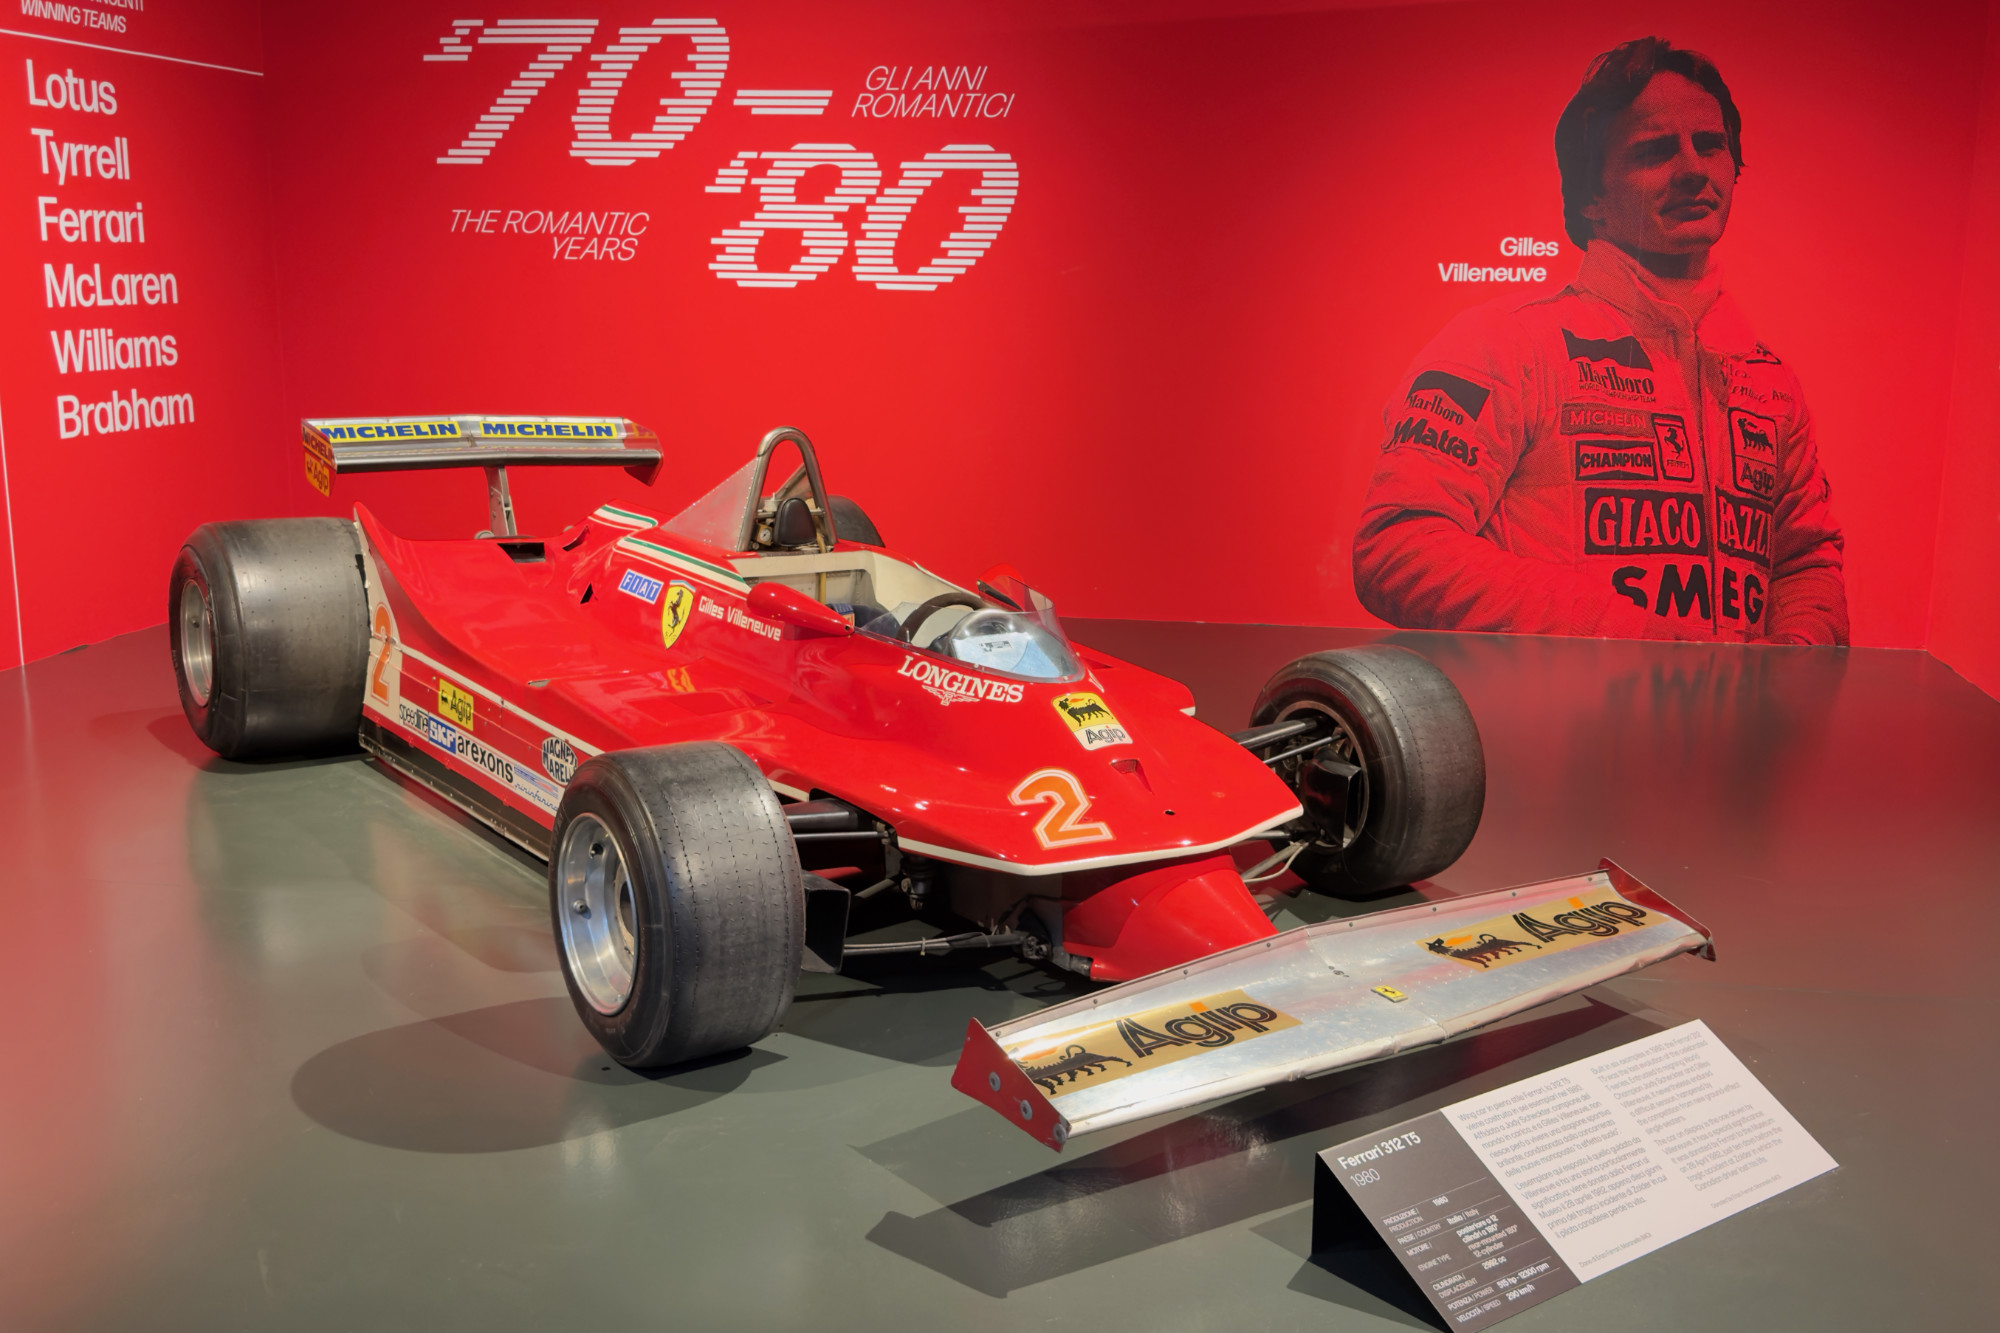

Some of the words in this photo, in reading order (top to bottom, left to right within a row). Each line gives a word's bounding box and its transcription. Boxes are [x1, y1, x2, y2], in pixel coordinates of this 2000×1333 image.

[20, 0, 82, 25] WINNING
[82, 8, 127, 33] TEAMS
[26, 58, 118, 116] Lotus
[864, 65, 911, 91] GLI
[915, 65, 988, 91] ANNI
[851, 92, 1015, 118] ROMANTICI
[31, 127, 131, 186] Tyrrell
[38, 196, 145, 243] Ferrari
[449, 209, 499, 234] THE
[502, 210, 650, 236] ROMANTIC
[550, 237, 638, 261] YEARS
[1500, 237, 1559, 257] Gilles
[43, 263, 179, 308] McLaren
[1438, 262, 1547, 283] Villeneuve
[50, 328, 179, 374] Williams
[1576, 361, 1655, 396] Marlboro
[57, 388, 195, 440] Brabham
[481, 422, 614, 438] MICHELIN
[1569, 410, 1647, 429] MICHELIN
[320, 422, 458, 440] MICHELIN
[1579, 452, 1653, 469] CHAMPION
[1740, 462, 1776, 495] Agip
[1588, 496, 1701, 549] GIACO
[621, 572, 661, 603] FIAT
[1612, 563, 1765, 625] SMEG
[698, 595, 725, 620] Gilles
[727, 605, 782, 642] Villeneuve
[371, 601, 394, 707] 2
[897, 655, 1025, 703] LONGINES
[450, 690, 472, 724] Agip
[1085, 725, 1126, 745] Agip
[457, 735, 514, 784] arexons
[1007, 766, 1116, 851] 2
[1513, 897, 1650, 945] Agip
[1114, 1000, 1278, 1059] Agip
[1457, 1111, 1477, 1121] Wing
[1492, 1099, 1511, 1110] pieno
[1510, 1094, 1524, 1103] stile
[1466, 1120, 1484, 1130] viene
[1484, 1110, 1513, 1124] costruita
[1527, 1094, 1557, 1108] esemplari
[1473, 1126, 1500, 1139] Affidata
[1505, 1119, 1521, 1128] Jody
[1551, 1097, 1581, 1111] campione
[1481, 1137, 1505, 1148] mondo
[1540, 1117, 1559, 1126] Gilles
[1489, 1147, 1510, 1158] riesce
[1560, 1118, 1587, 1131] stagione
[1337, 1144, 1384, 1169] Ferrari
[1380, 1137, 1405, 1153] 312
[1400, 1131, 1420, 1145] T5
[1520, 1159, 1541, 1170] nuove
[1539, 1146, 1575, 1163] monoposto
[1350, 1168, 1380, 1186] 1980
[1432, 1195, 1448, 1205] 1980
[1446, 1214, 1463, 1224] Italia
[1464, 1208, 1479, 1217] Italy
[1456, 1220, 1486, 1237] posteriore
[1436, 1253, 1451, 1262] TYPE
[1517, 1266, 1537, 1278] 12300
[1535, 1262, 1549, 1272] rpm
[1482, 1299, 1501, 1310] SPEED
[1505, 1289, 1519, 1300] 290
